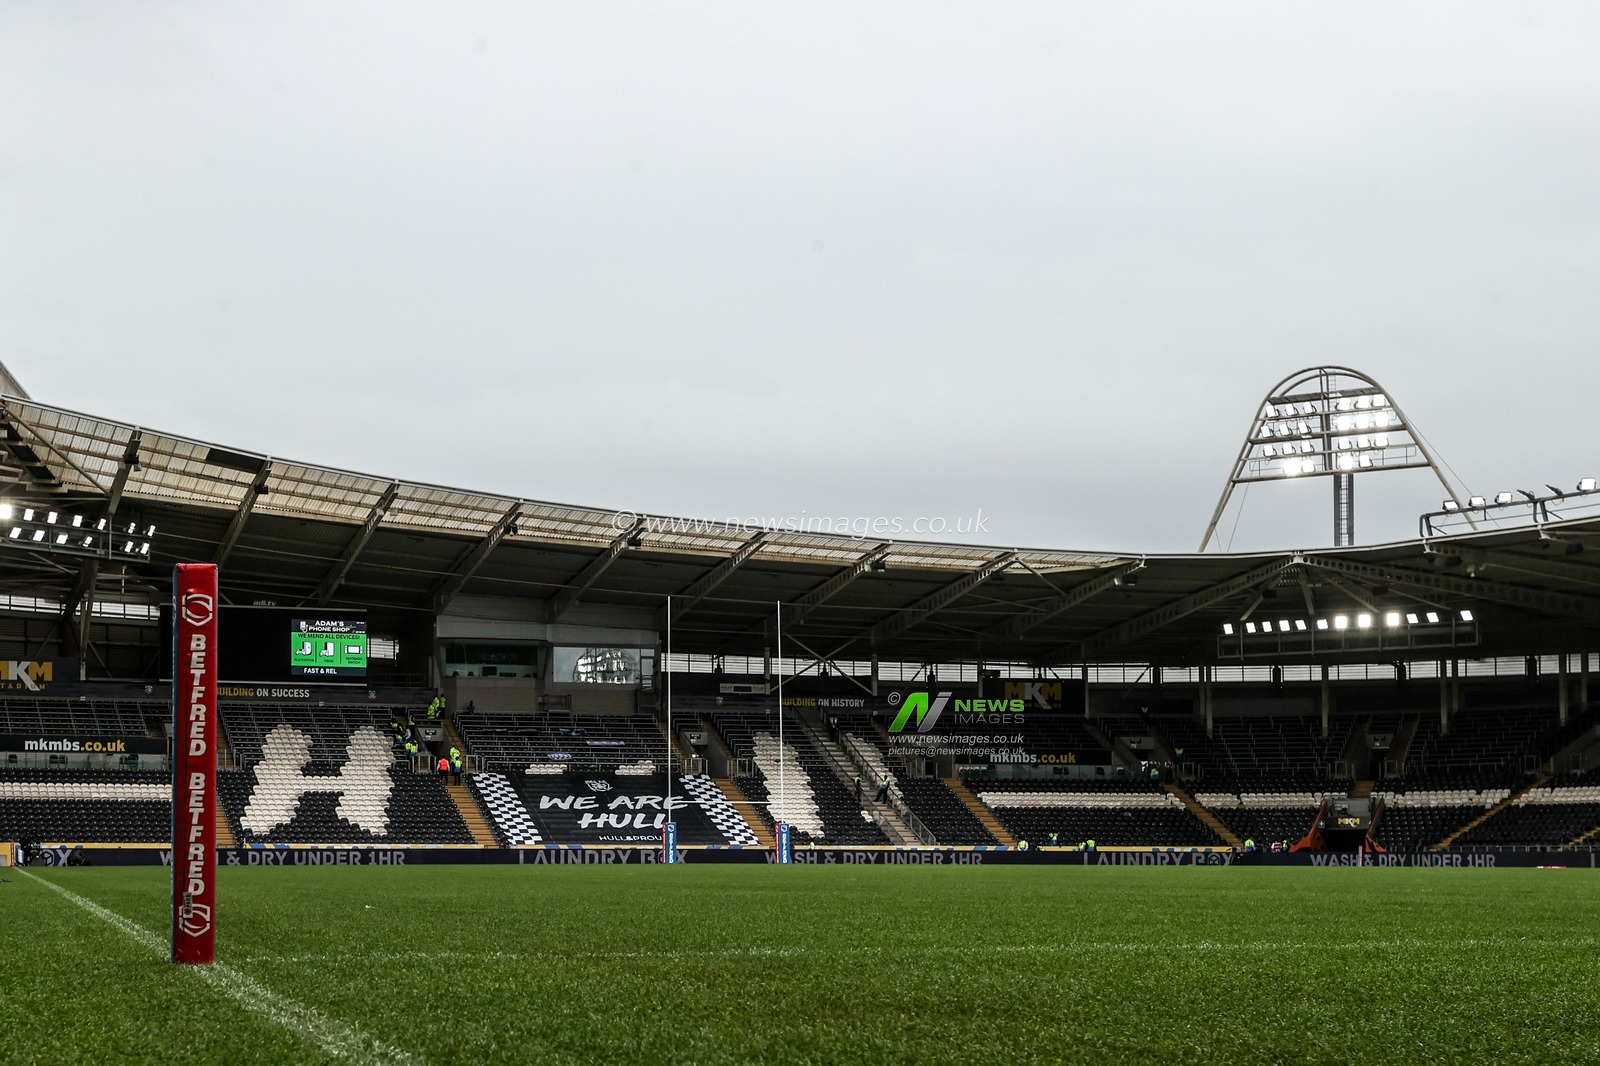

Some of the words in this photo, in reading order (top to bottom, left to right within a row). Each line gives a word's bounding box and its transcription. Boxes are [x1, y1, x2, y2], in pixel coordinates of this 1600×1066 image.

[189, 634, 207, 756] BETFRED
[256, 688, 269, 697] ON
[271, 688, 310, 698] SUCCESS
[1004, 682, 1062, 709] MKM
[818, 698, 829, 707] ON
[831, 698, 865, 708] HISTORY
[24, 738, 126, 752] mkmbs.co.uk
[990, 750, 1077, 765] mkmbs.co.uk
[539, 795, 599, 810] WE
[607, 795, 688, 810] ARE
[577, 813, 667, 830] HULL
[188, 772, 206, 896] BETFRED
[226, 851, 241, 866] &
[250, 851, 285, 866] DRY
[293, 851, 362, 866] UNDER
[368, 851, 405, 866] 1HR
[519, 849, 632, 864] LAUNDRY
[824, 852, 836, 865] &
[843, 852, 878, 865] DRY
[884, 852, 944, 865] UNDER
[950, 852, 983, 865] 1HR
[1083, 852, 1184, 866] LAUNDRY
[1310, 854, 1360, 867] WASH
[1364, 854, 1375, 867] &
[1379, 854, 1407, 868] DRY
[1411, 854, 1462, 868] UNDER
[1467, 854, 1496, 868] 1HR
